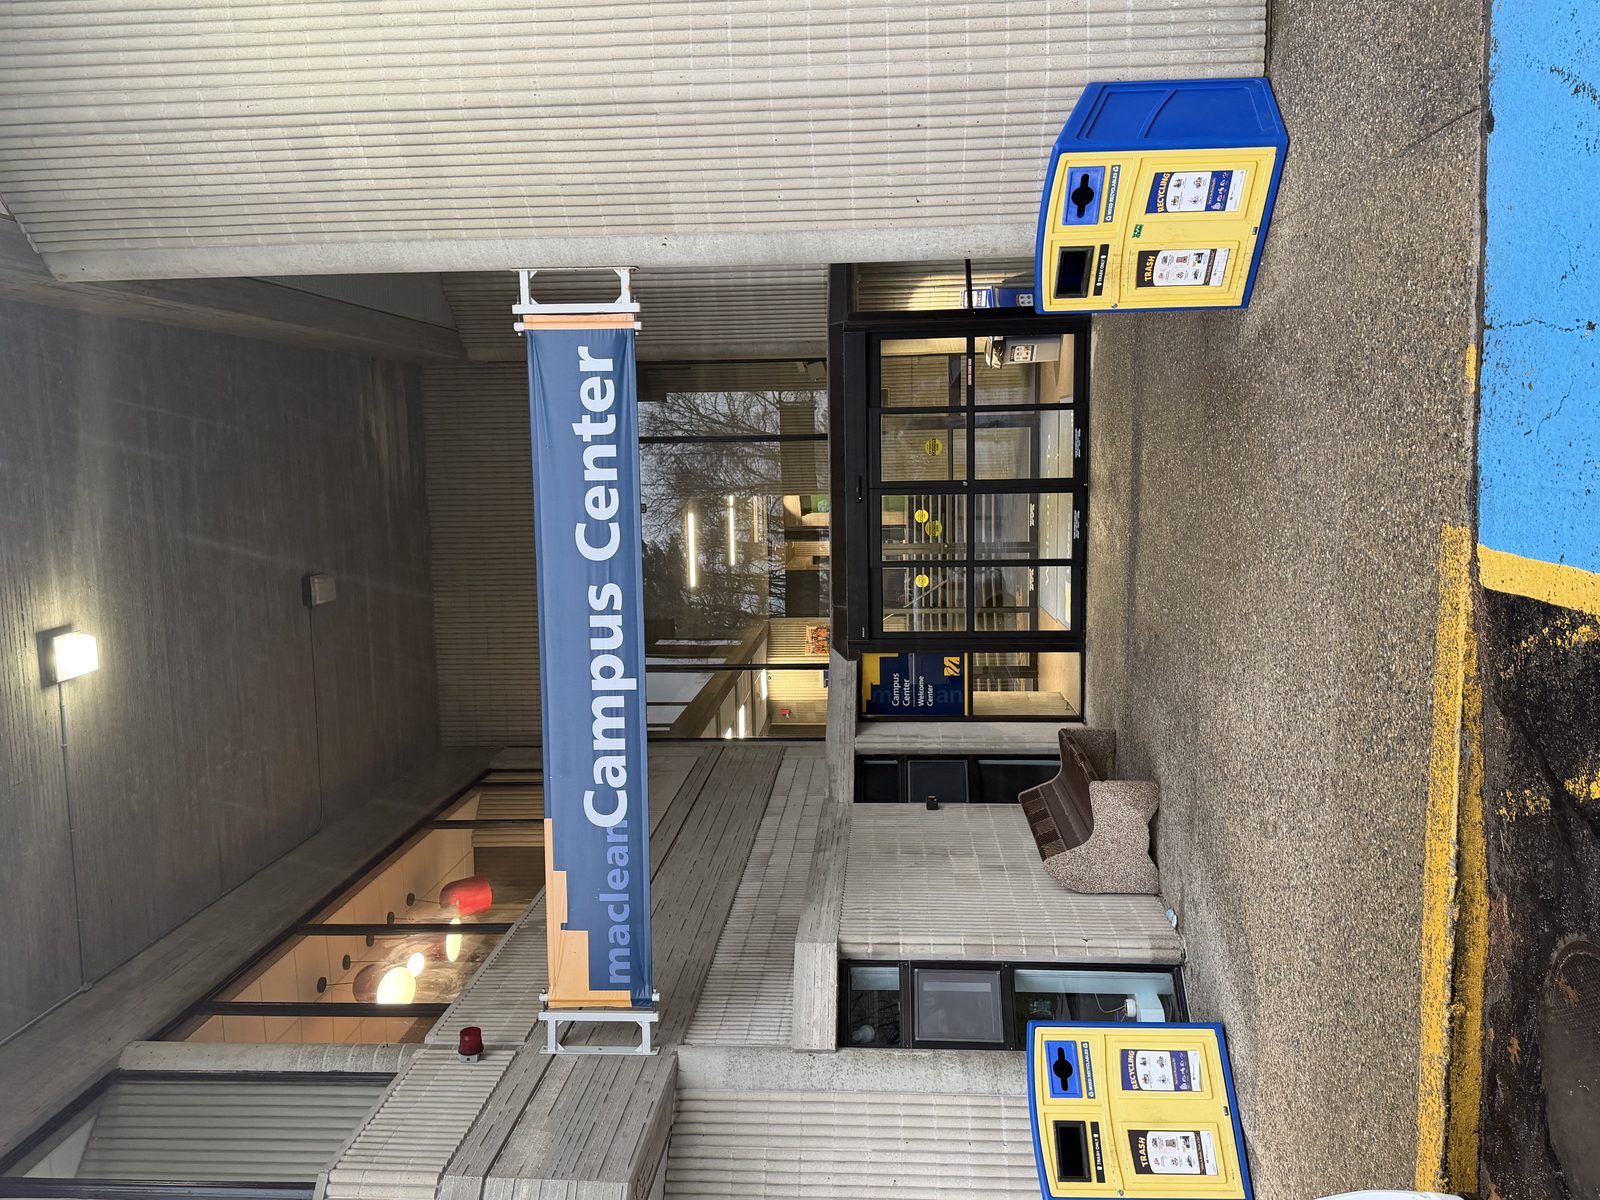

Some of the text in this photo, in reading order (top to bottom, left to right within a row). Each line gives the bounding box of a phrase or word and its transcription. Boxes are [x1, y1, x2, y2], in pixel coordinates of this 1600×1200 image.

[1156, 172, 1170, 212] RECYCLING
[1144, 256, 1156, 282] TRASH
[572, 346, 638, 827] Campus Center
[892, 673, 901, 706] Campus
[902, 678, 910, 706] Center
[926, 684, 934, 706] Center
[599, 819, 631, 984] maclean
[1128, 1050, 1139, 1090] RECYCLING
[1138, 1136, 1148, 1168] TRASH
